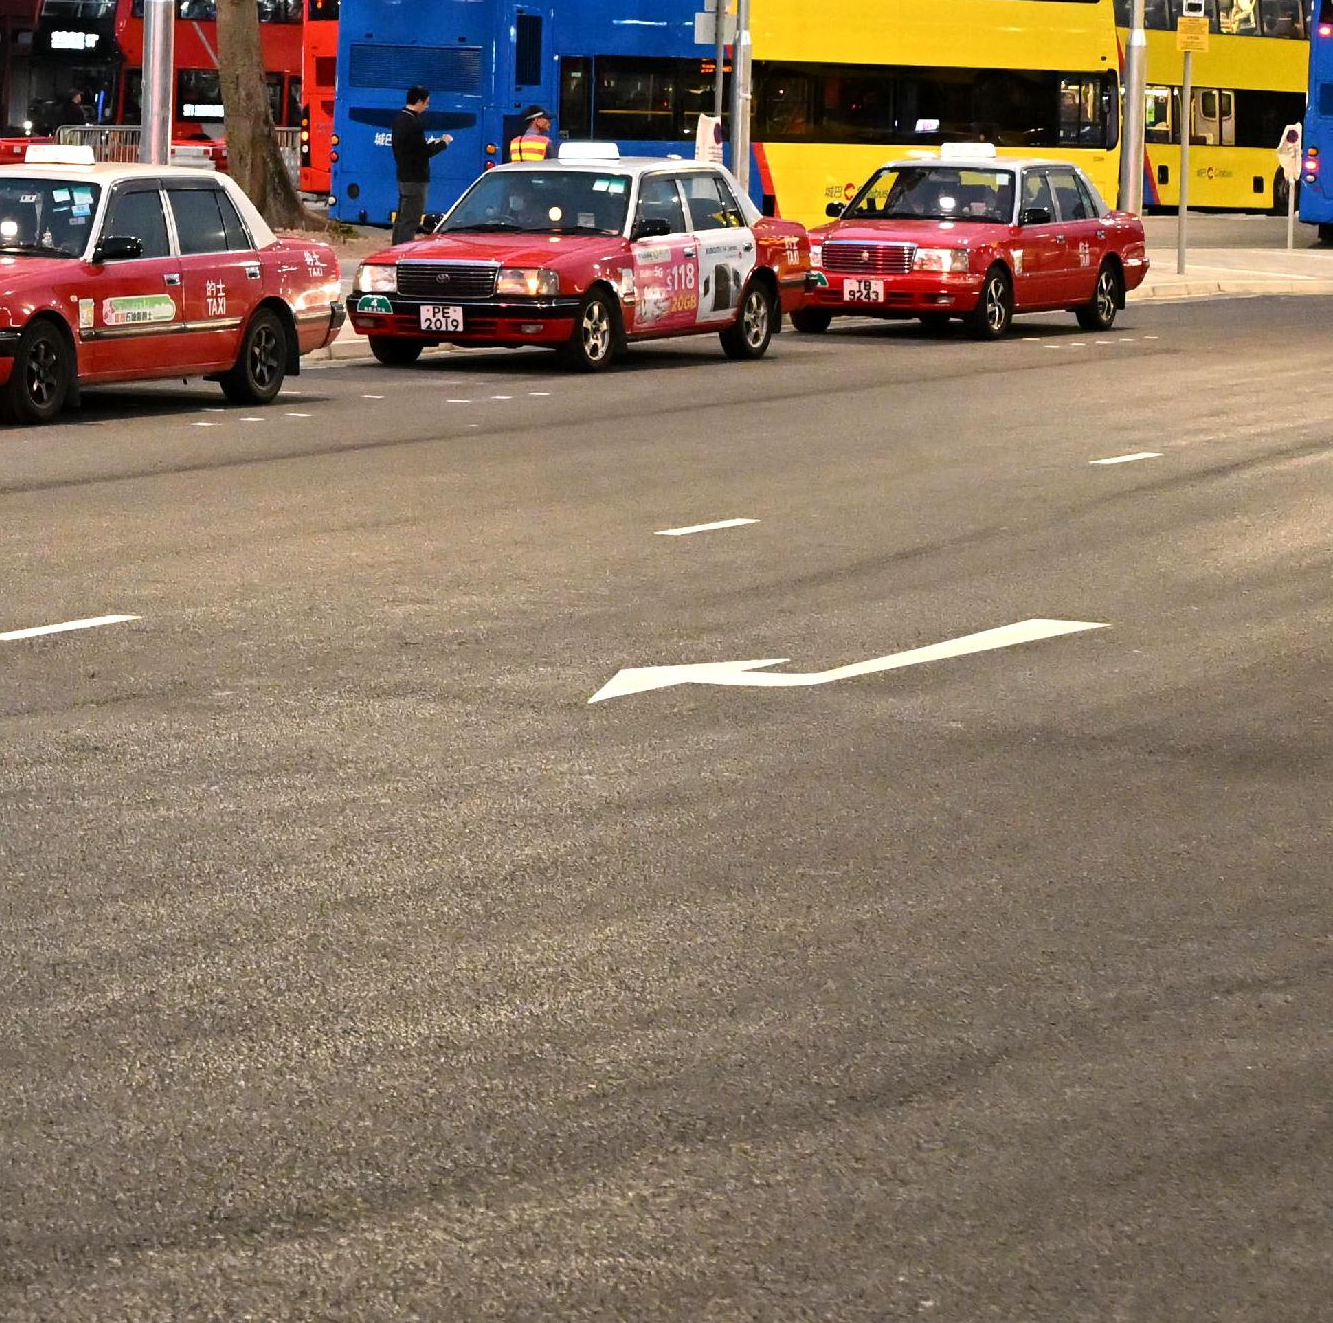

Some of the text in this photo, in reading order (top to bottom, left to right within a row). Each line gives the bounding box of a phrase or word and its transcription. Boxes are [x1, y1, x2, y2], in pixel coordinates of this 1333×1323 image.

[206, 280, 226, 296] 的士
[857, 280, 871, 291] TB
[848, 289, 879, 301] 9243
[207, 297, 226, 315] TAXI
[371, 298, 378, 306] 4
[432, 306, 450, 318] PE
[425, 318, 459, 330] 2019
